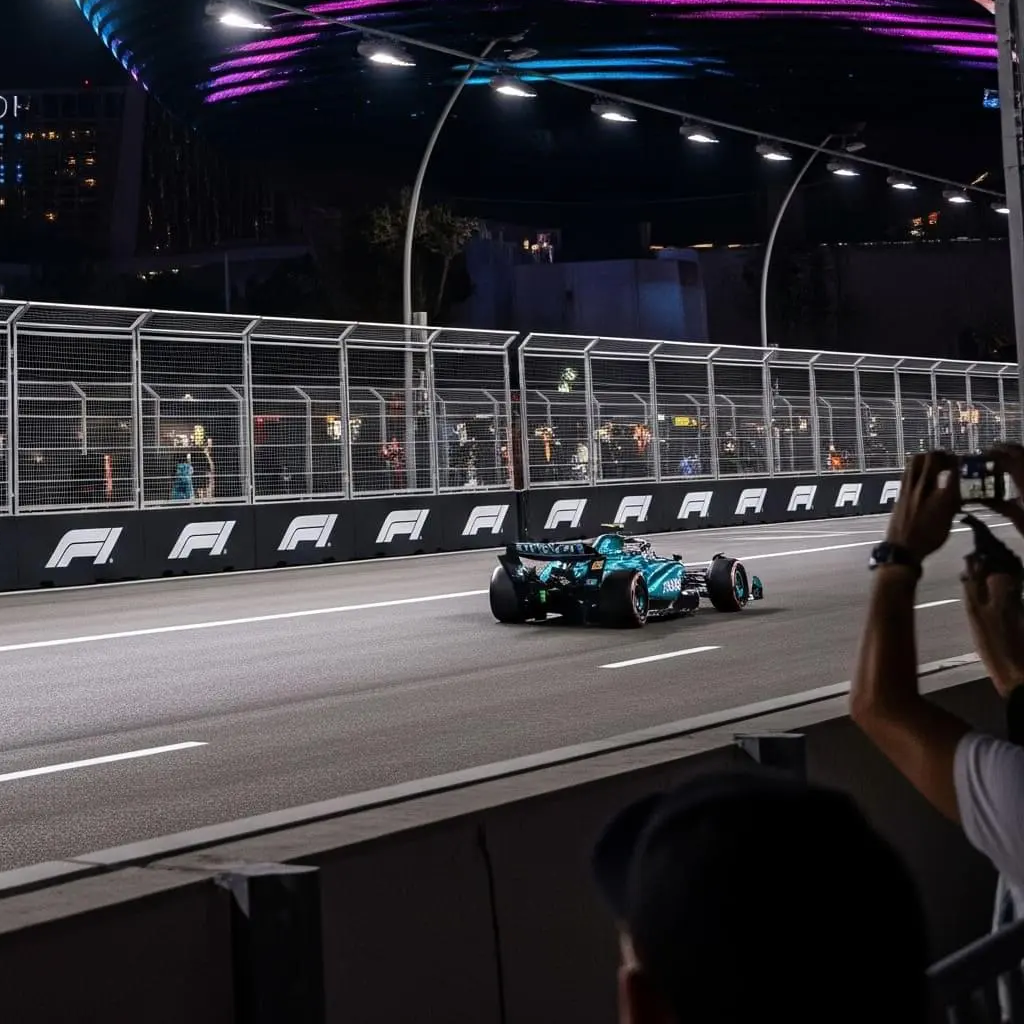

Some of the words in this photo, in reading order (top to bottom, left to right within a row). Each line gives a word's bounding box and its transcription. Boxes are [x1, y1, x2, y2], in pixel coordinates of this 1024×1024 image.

[613, 495, 652, 523] F1
[677, 491, 713, 519] F1
[735, 488, 767, 514] F1
[787, 485, 817, 511] F1
[835, 483, 862, 507] F1
[376, 509, 429, 543] F1
[462, 505, 509, 535] F1
[544, 499, 587, 529] F1
[168, 521, 236, 559] F1
[278, 514, 338, 550] F1
[45, 527, 123, 568] F1
